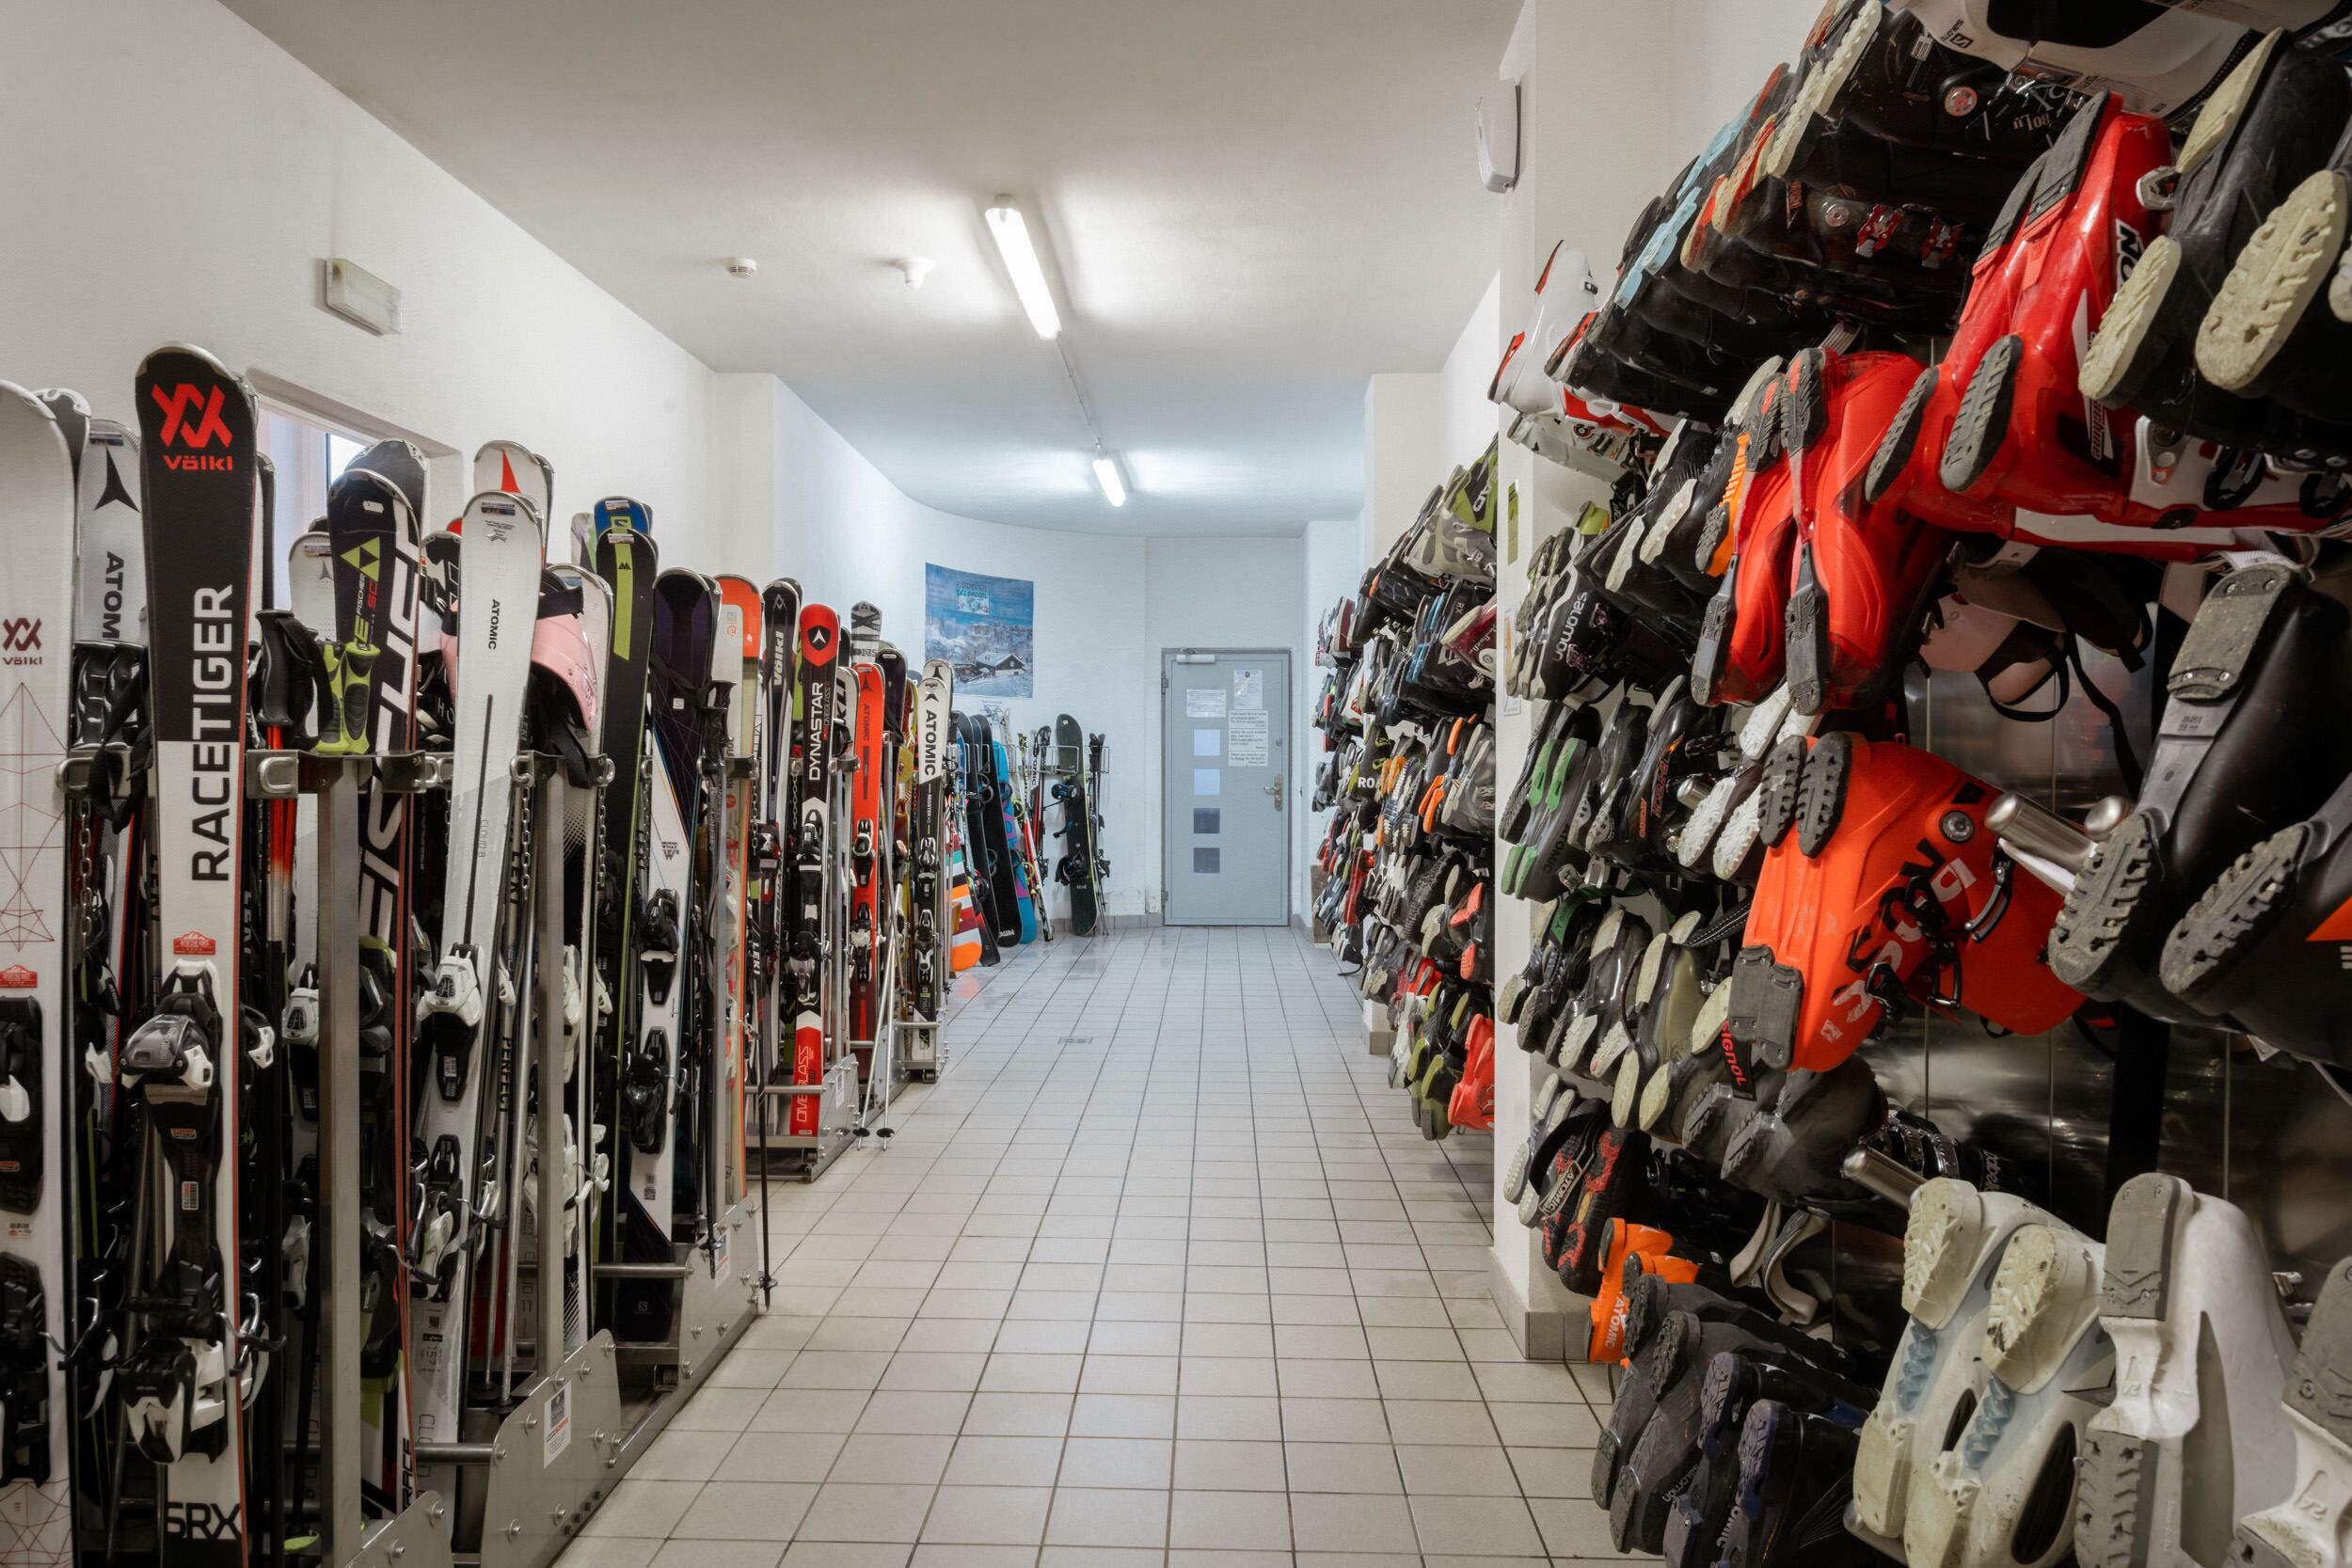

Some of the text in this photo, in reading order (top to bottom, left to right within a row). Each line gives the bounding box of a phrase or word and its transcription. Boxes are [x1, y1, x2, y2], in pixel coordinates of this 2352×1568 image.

[2090, 399, 2104, 460] achine
[164, 454, 233, 471] Völkl
[102, 550, 125, 639] ATOM
[357, 573, 366, 616] FISCHER
[367, 579, 378, 608] SC
[488, 598, 501, 651] ATOMIC
[1552, 591, 1588, 662] salomon
[3, 656, 43, 666] Völkl
[773, 630, 785, 686] Völkl
[191, 583, 233, 881] RACETIGER
[808, 681, 824, 781] DYNASTAR
[925, 708, 937, 776] ATOMIC
[509, 850, 519, 905] LEKI
[752, 942, 760, 975] LEKI
[501, 1037, 512, 1114] PERFECT
[1548, 1168, 1577, 1212] ATOMIC
[1984, 1150, 2002, 1193] dalbell
[1602, 1298, 1627, 1350] ATOMIC
[165, 1502, 242, 1540] SRX
[1717, 1505, 1741, 1548] OMIC
